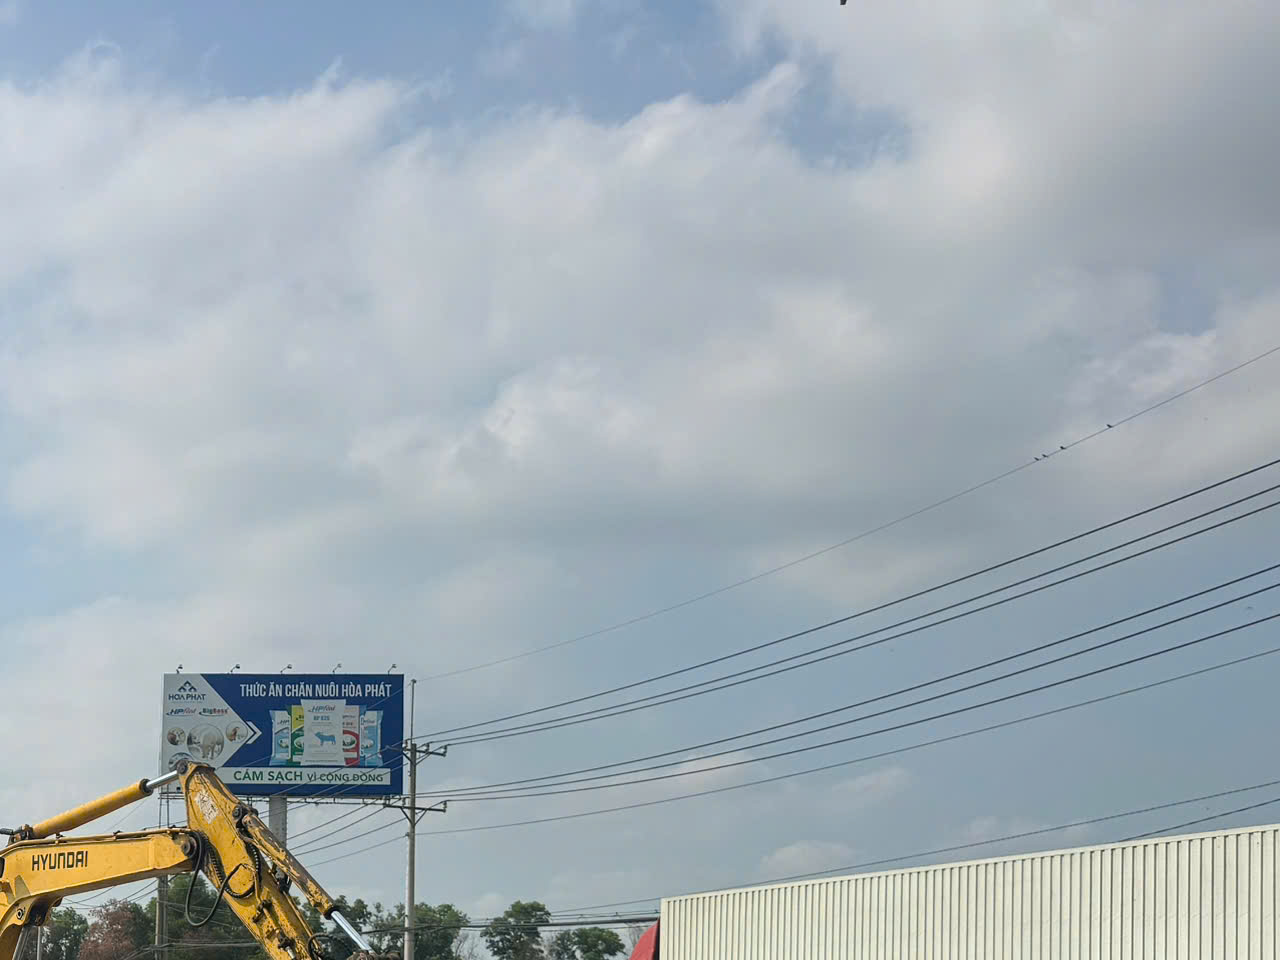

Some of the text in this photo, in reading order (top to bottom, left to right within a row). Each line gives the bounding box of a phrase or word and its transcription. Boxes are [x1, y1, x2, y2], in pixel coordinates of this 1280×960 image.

[240, 682, 392, 697] THỨC ĂN CHĂN NUÔI HÒA PHÁT
[267, 771, 303, 784] SẠCH
[32, 850, 88, 871] HYUNDAI
